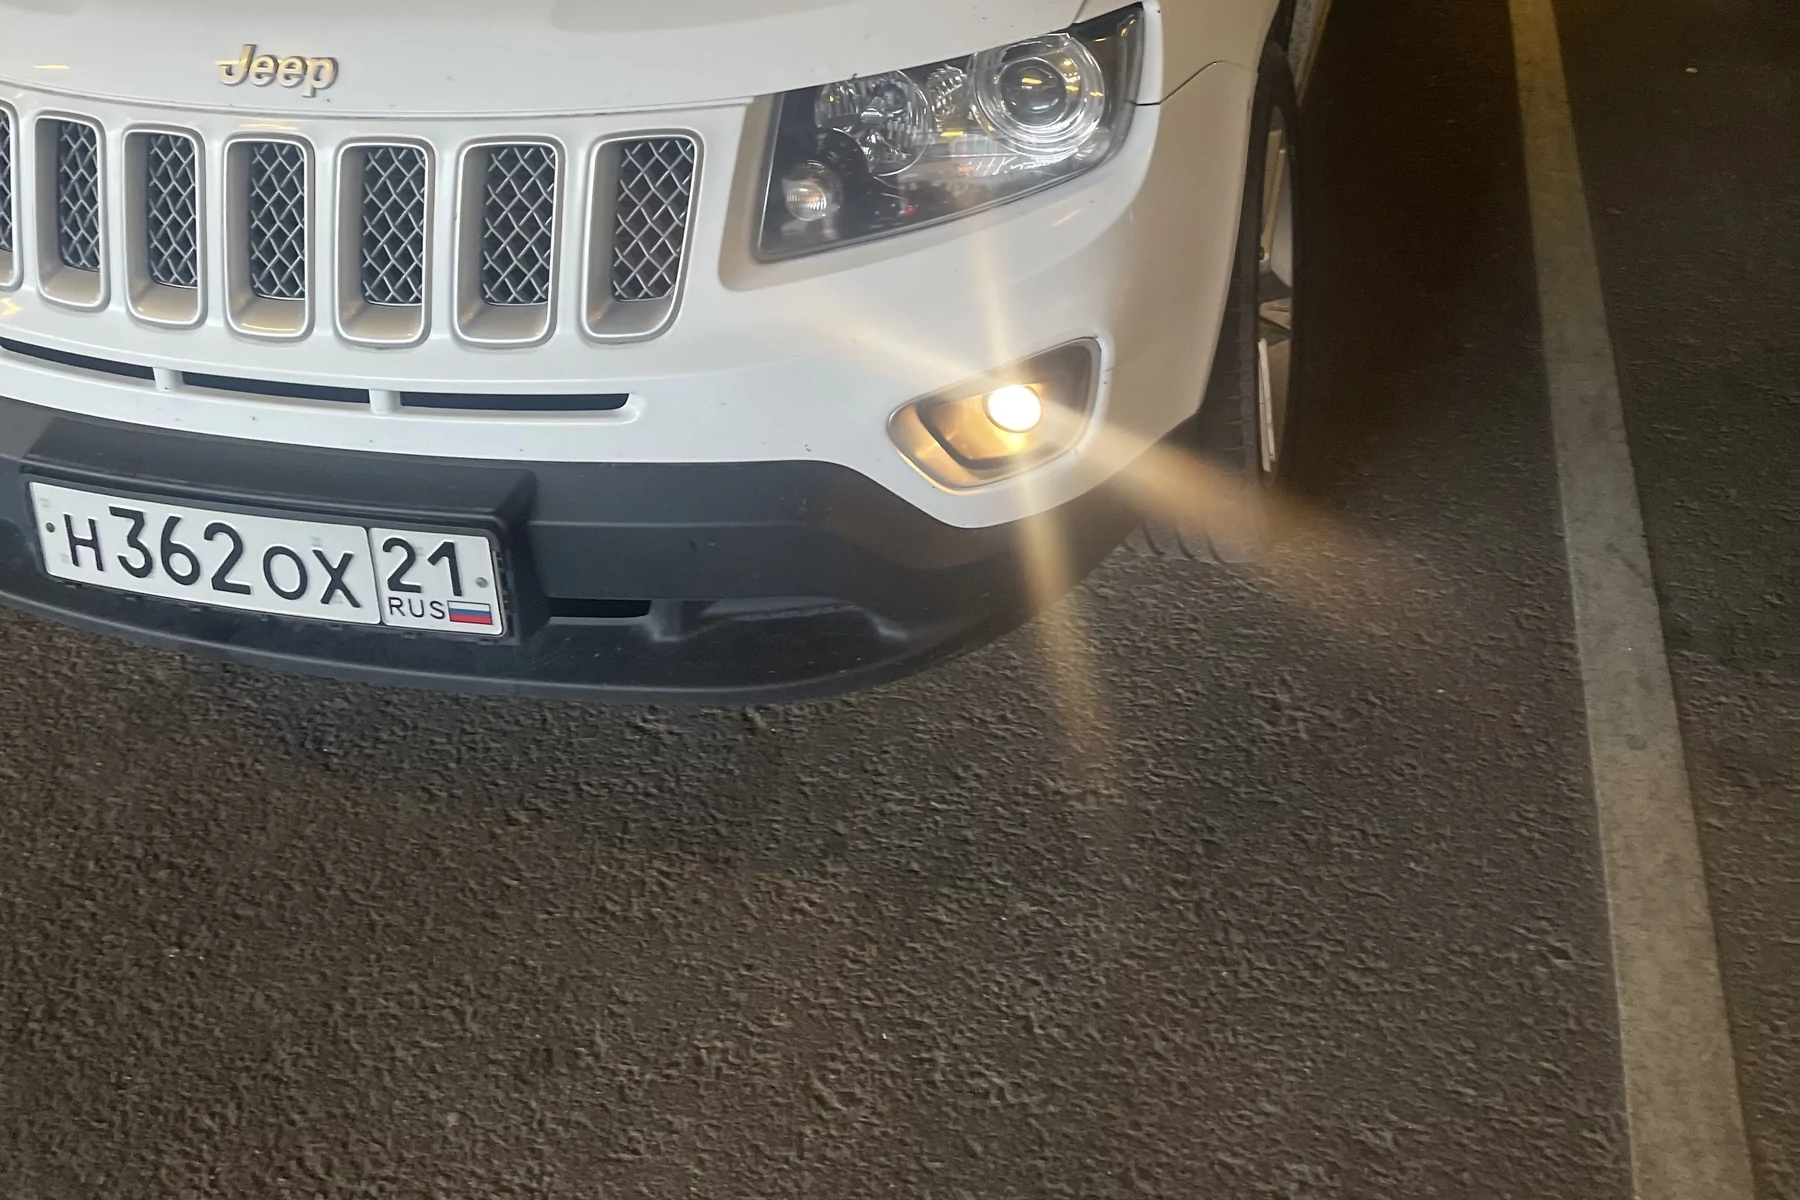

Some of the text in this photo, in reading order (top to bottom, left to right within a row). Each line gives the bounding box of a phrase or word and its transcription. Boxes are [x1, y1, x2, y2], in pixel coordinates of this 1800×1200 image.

[214, 43, 339, 98] Jeep
[381, 536, 463, 597] 21
[387, 596, 446, 620] RUS
